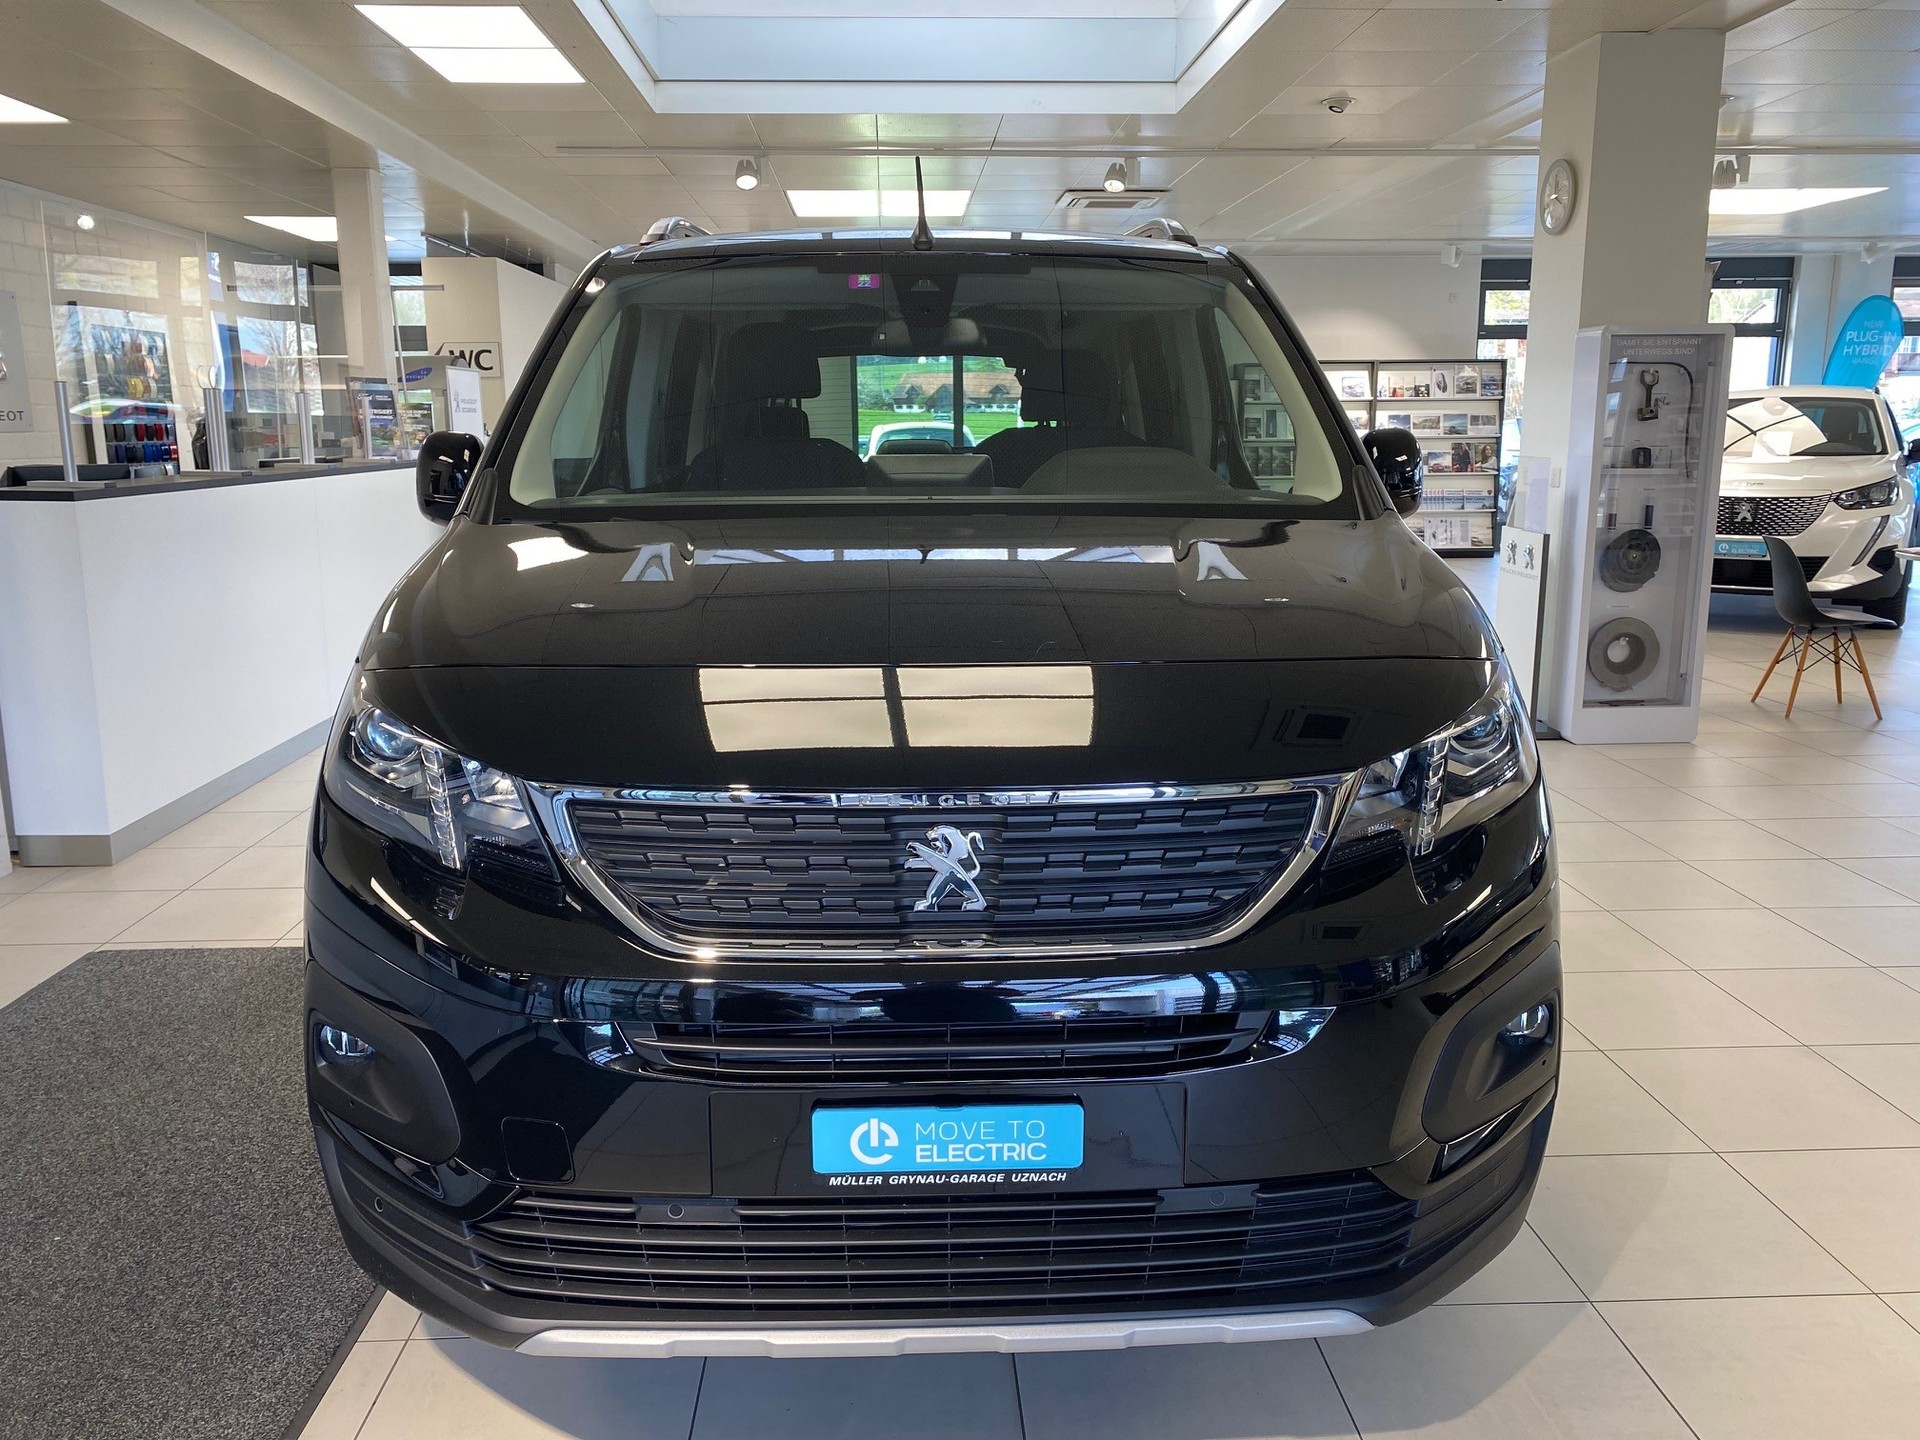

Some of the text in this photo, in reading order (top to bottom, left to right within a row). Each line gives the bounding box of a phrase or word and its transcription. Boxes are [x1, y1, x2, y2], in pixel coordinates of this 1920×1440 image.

[1616, 337, 1703, 346] DAMIT SIE ENTSPANNT
[1846, 330, 1898, 342] PLUG-IN
[1623, 347, 1695, 355] UNTERWEGS SIND!
[1843, 344, 1895, 357] HYBRID
[448, 349, 494, 371] WC
[857, 793, 1036, 808] PEUGEOT
[915, 1120, 1046, 1141] MOVE TO
[915, 1142, 1047, 1164] ELECTRIC
[829, 1171, 1067, 1186] MÜLLER GRYNAU-GARAGE UZNACH
